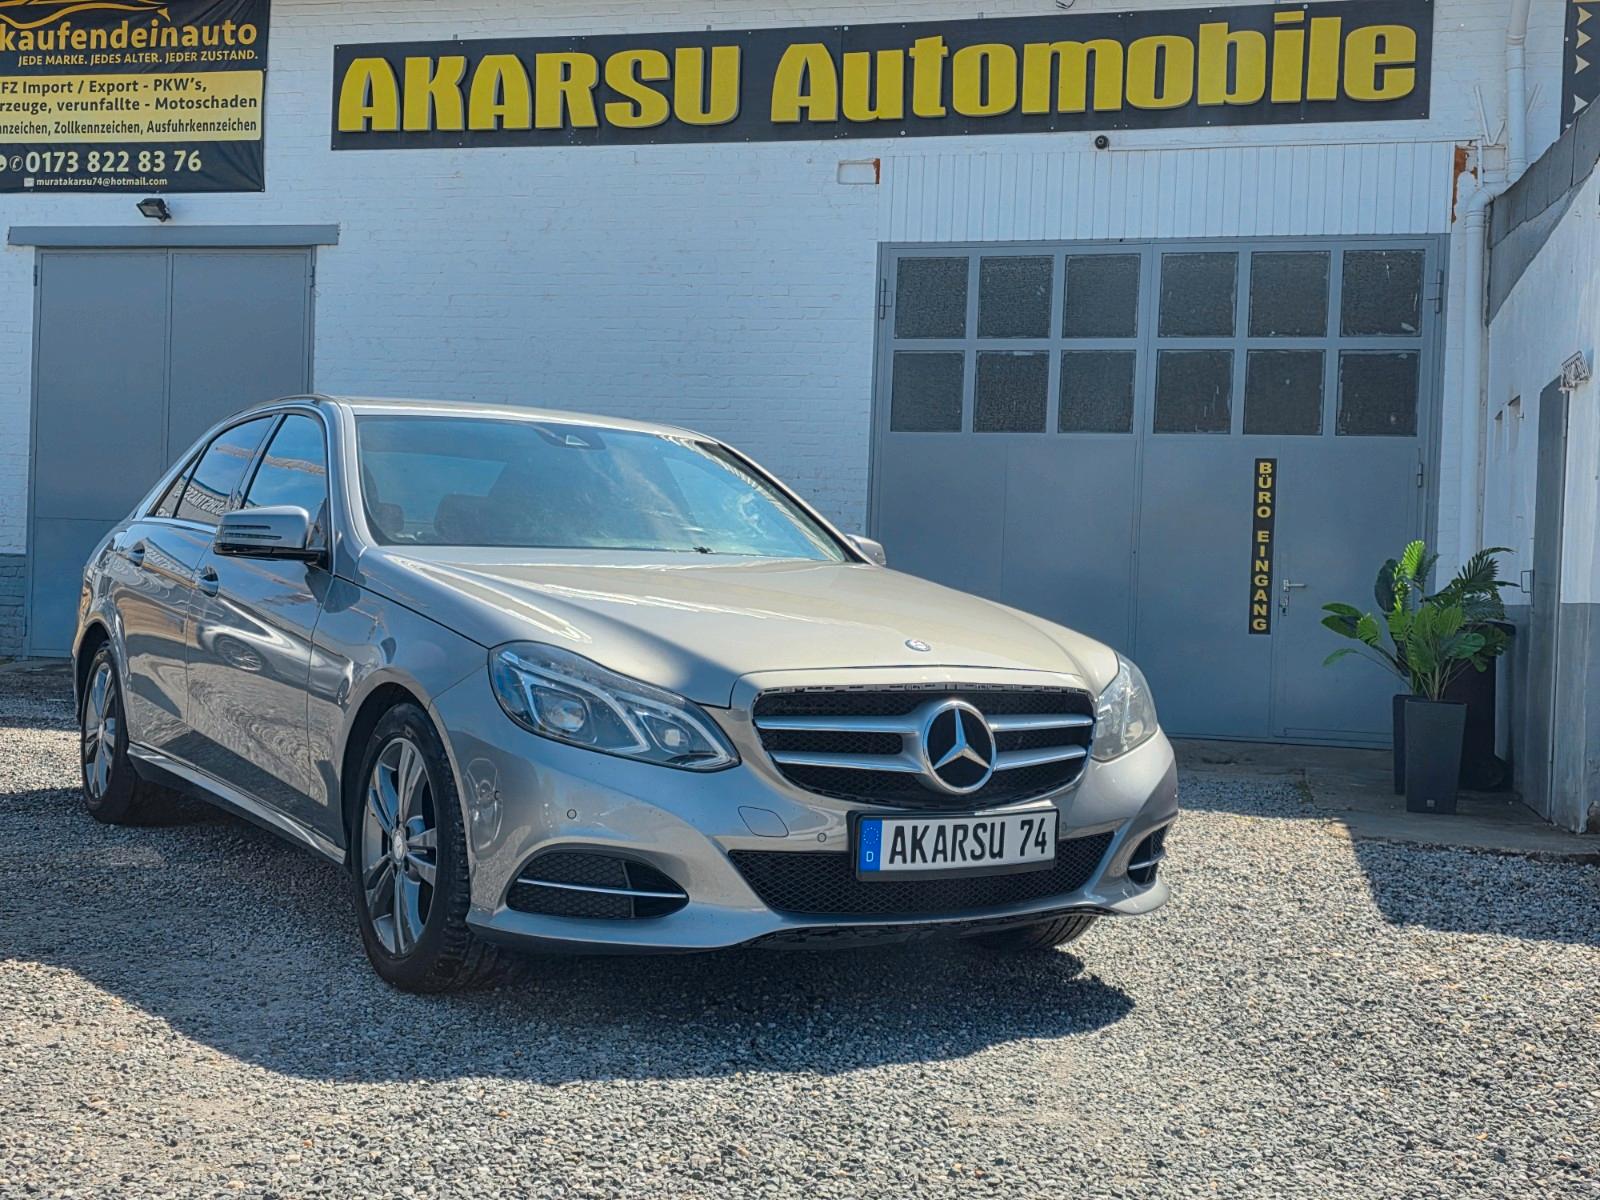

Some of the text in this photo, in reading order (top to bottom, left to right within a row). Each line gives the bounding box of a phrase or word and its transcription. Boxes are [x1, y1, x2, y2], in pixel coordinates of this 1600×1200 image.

[0, 19, 257, 51] kaufendeinauto
[18, 49, 259, 67] JEDE MARKE. JEDES ALTER. JEDER ZUSTAND.
[338, 11, 1417, 132] AKARSU Automobile
[23, 80, 73, 97] Import
[77, 80, 84, 94] /
[89, 79, 139, 96] Export
[153, 77, 207, 92] PKW's,
[0, 100, 52, 115] rzeuge,
[57, 97, 140, 112] verunfallte
[155, 94, 257, 110] Motoschaden
[54, 120, 143, 135] Zollkennzeichen,
[147, 117, 257, 133] Ausfuhrkennzeichen
[25, 150, 202, 173] 0173 822 83 76
[36, 177, 168, 187] muratakarsu74@hotmail.com
[1252, 462, 1272, 631] BÜRO EINGANG
[888, 822, 1006, 865] AKARSU
[1019, 817, 1048, 857] 74
